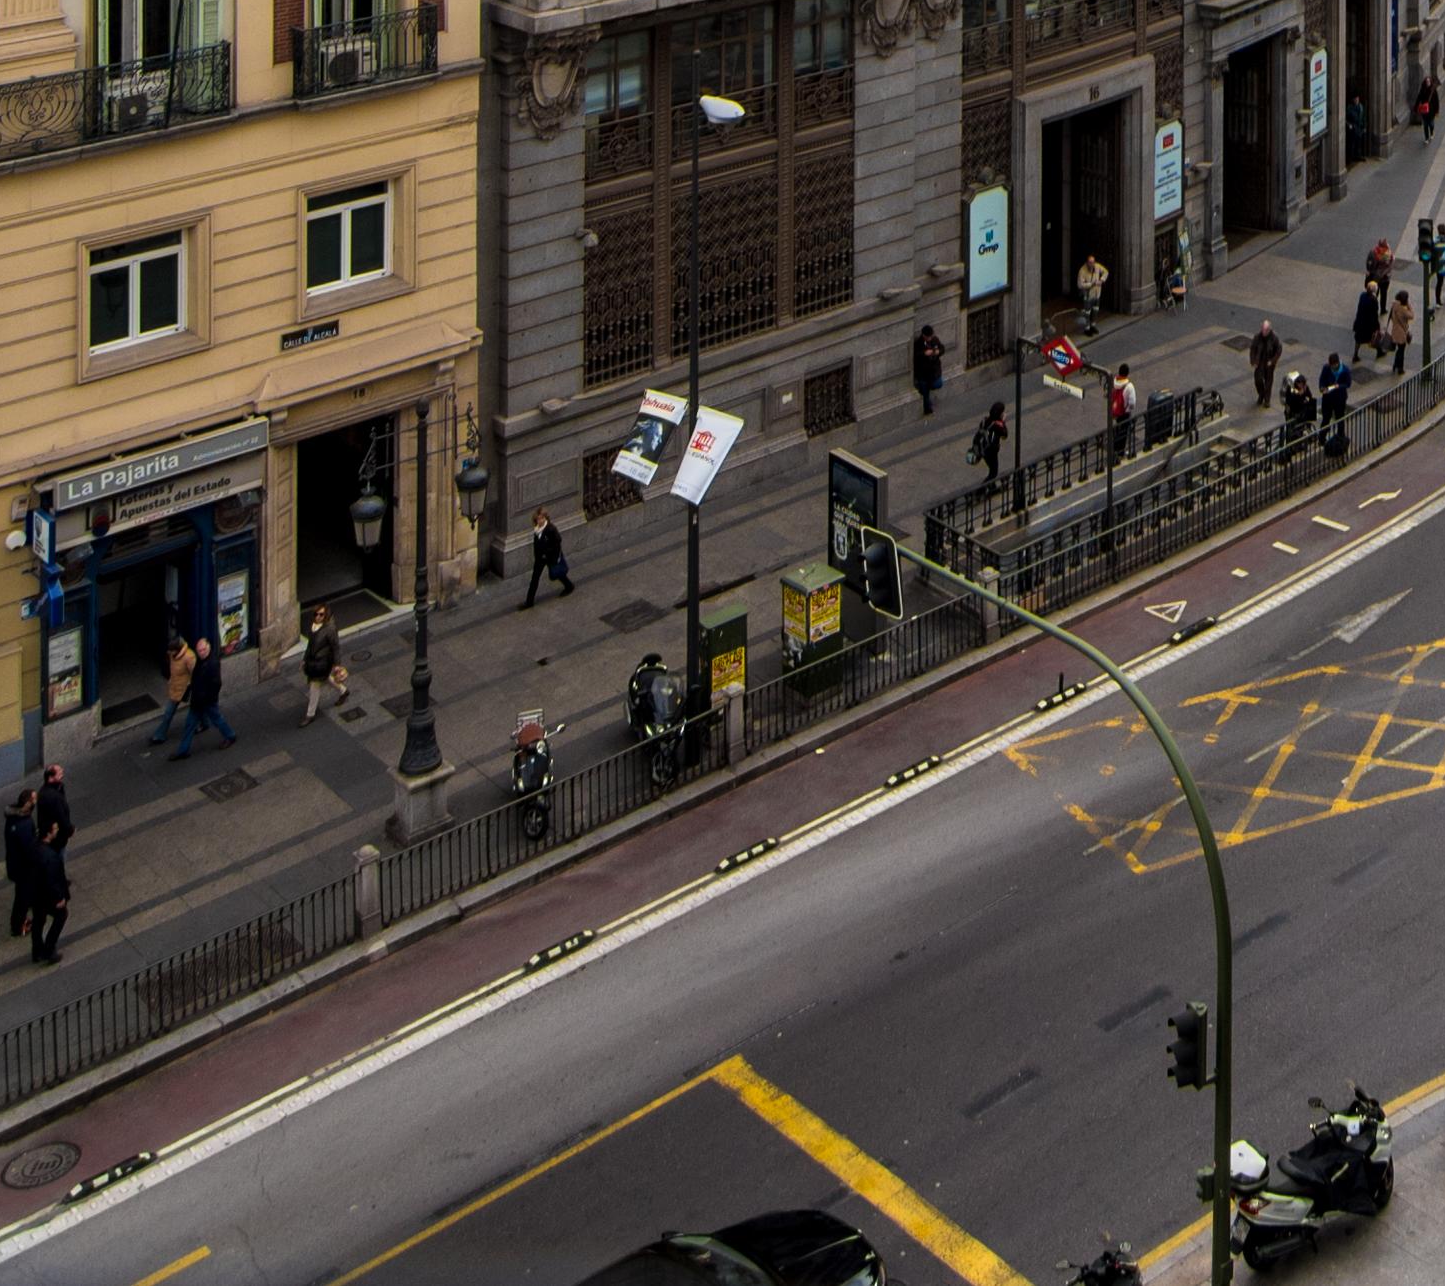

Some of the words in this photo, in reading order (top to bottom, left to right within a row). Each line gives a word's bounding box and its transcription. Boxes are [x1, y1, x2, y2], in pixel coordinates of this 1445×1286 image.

[1088, 84, 1100, 101] 16
[284, 336, 302, 349] CALLE
[68, 480, 94, 500] La
[101, 452, 180, 490] Pajarita
[119, 496, 172, 521] Apuestas
[173, 488, 191, 503] del
[194, 477, 232, 496] Estado
